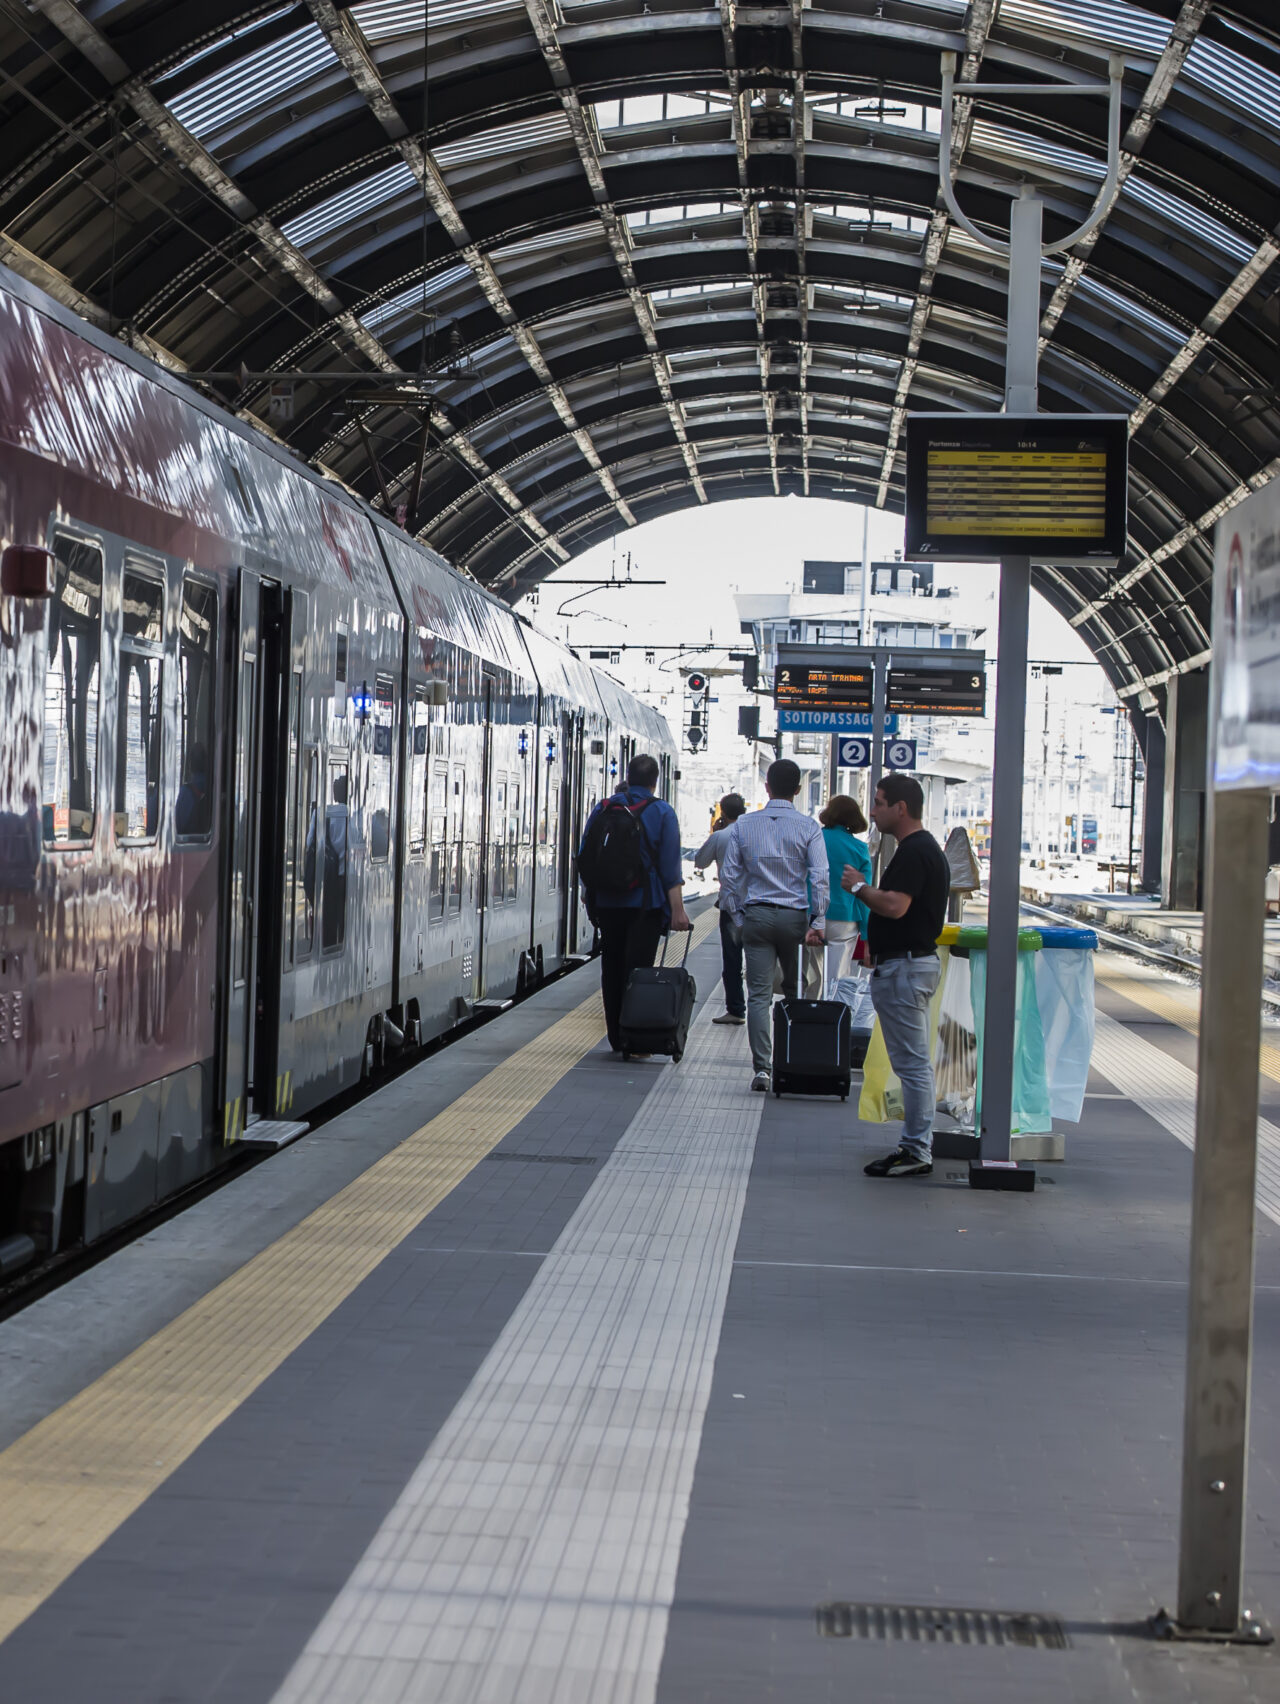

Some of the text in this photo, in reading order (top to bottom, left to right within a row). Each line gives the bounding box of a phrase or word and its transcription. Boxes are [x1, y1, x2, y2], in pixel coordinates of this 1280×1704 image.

[1017, 441, 1037, 449] 10:14
[781, 670, 790, 682] 2
[971, 676, 980, 688] 3
[784, 711, 891, 725] SOTTOPASSAGO
[847, 744, 860, 760] 2
[895, 747, 907, 762] 3
